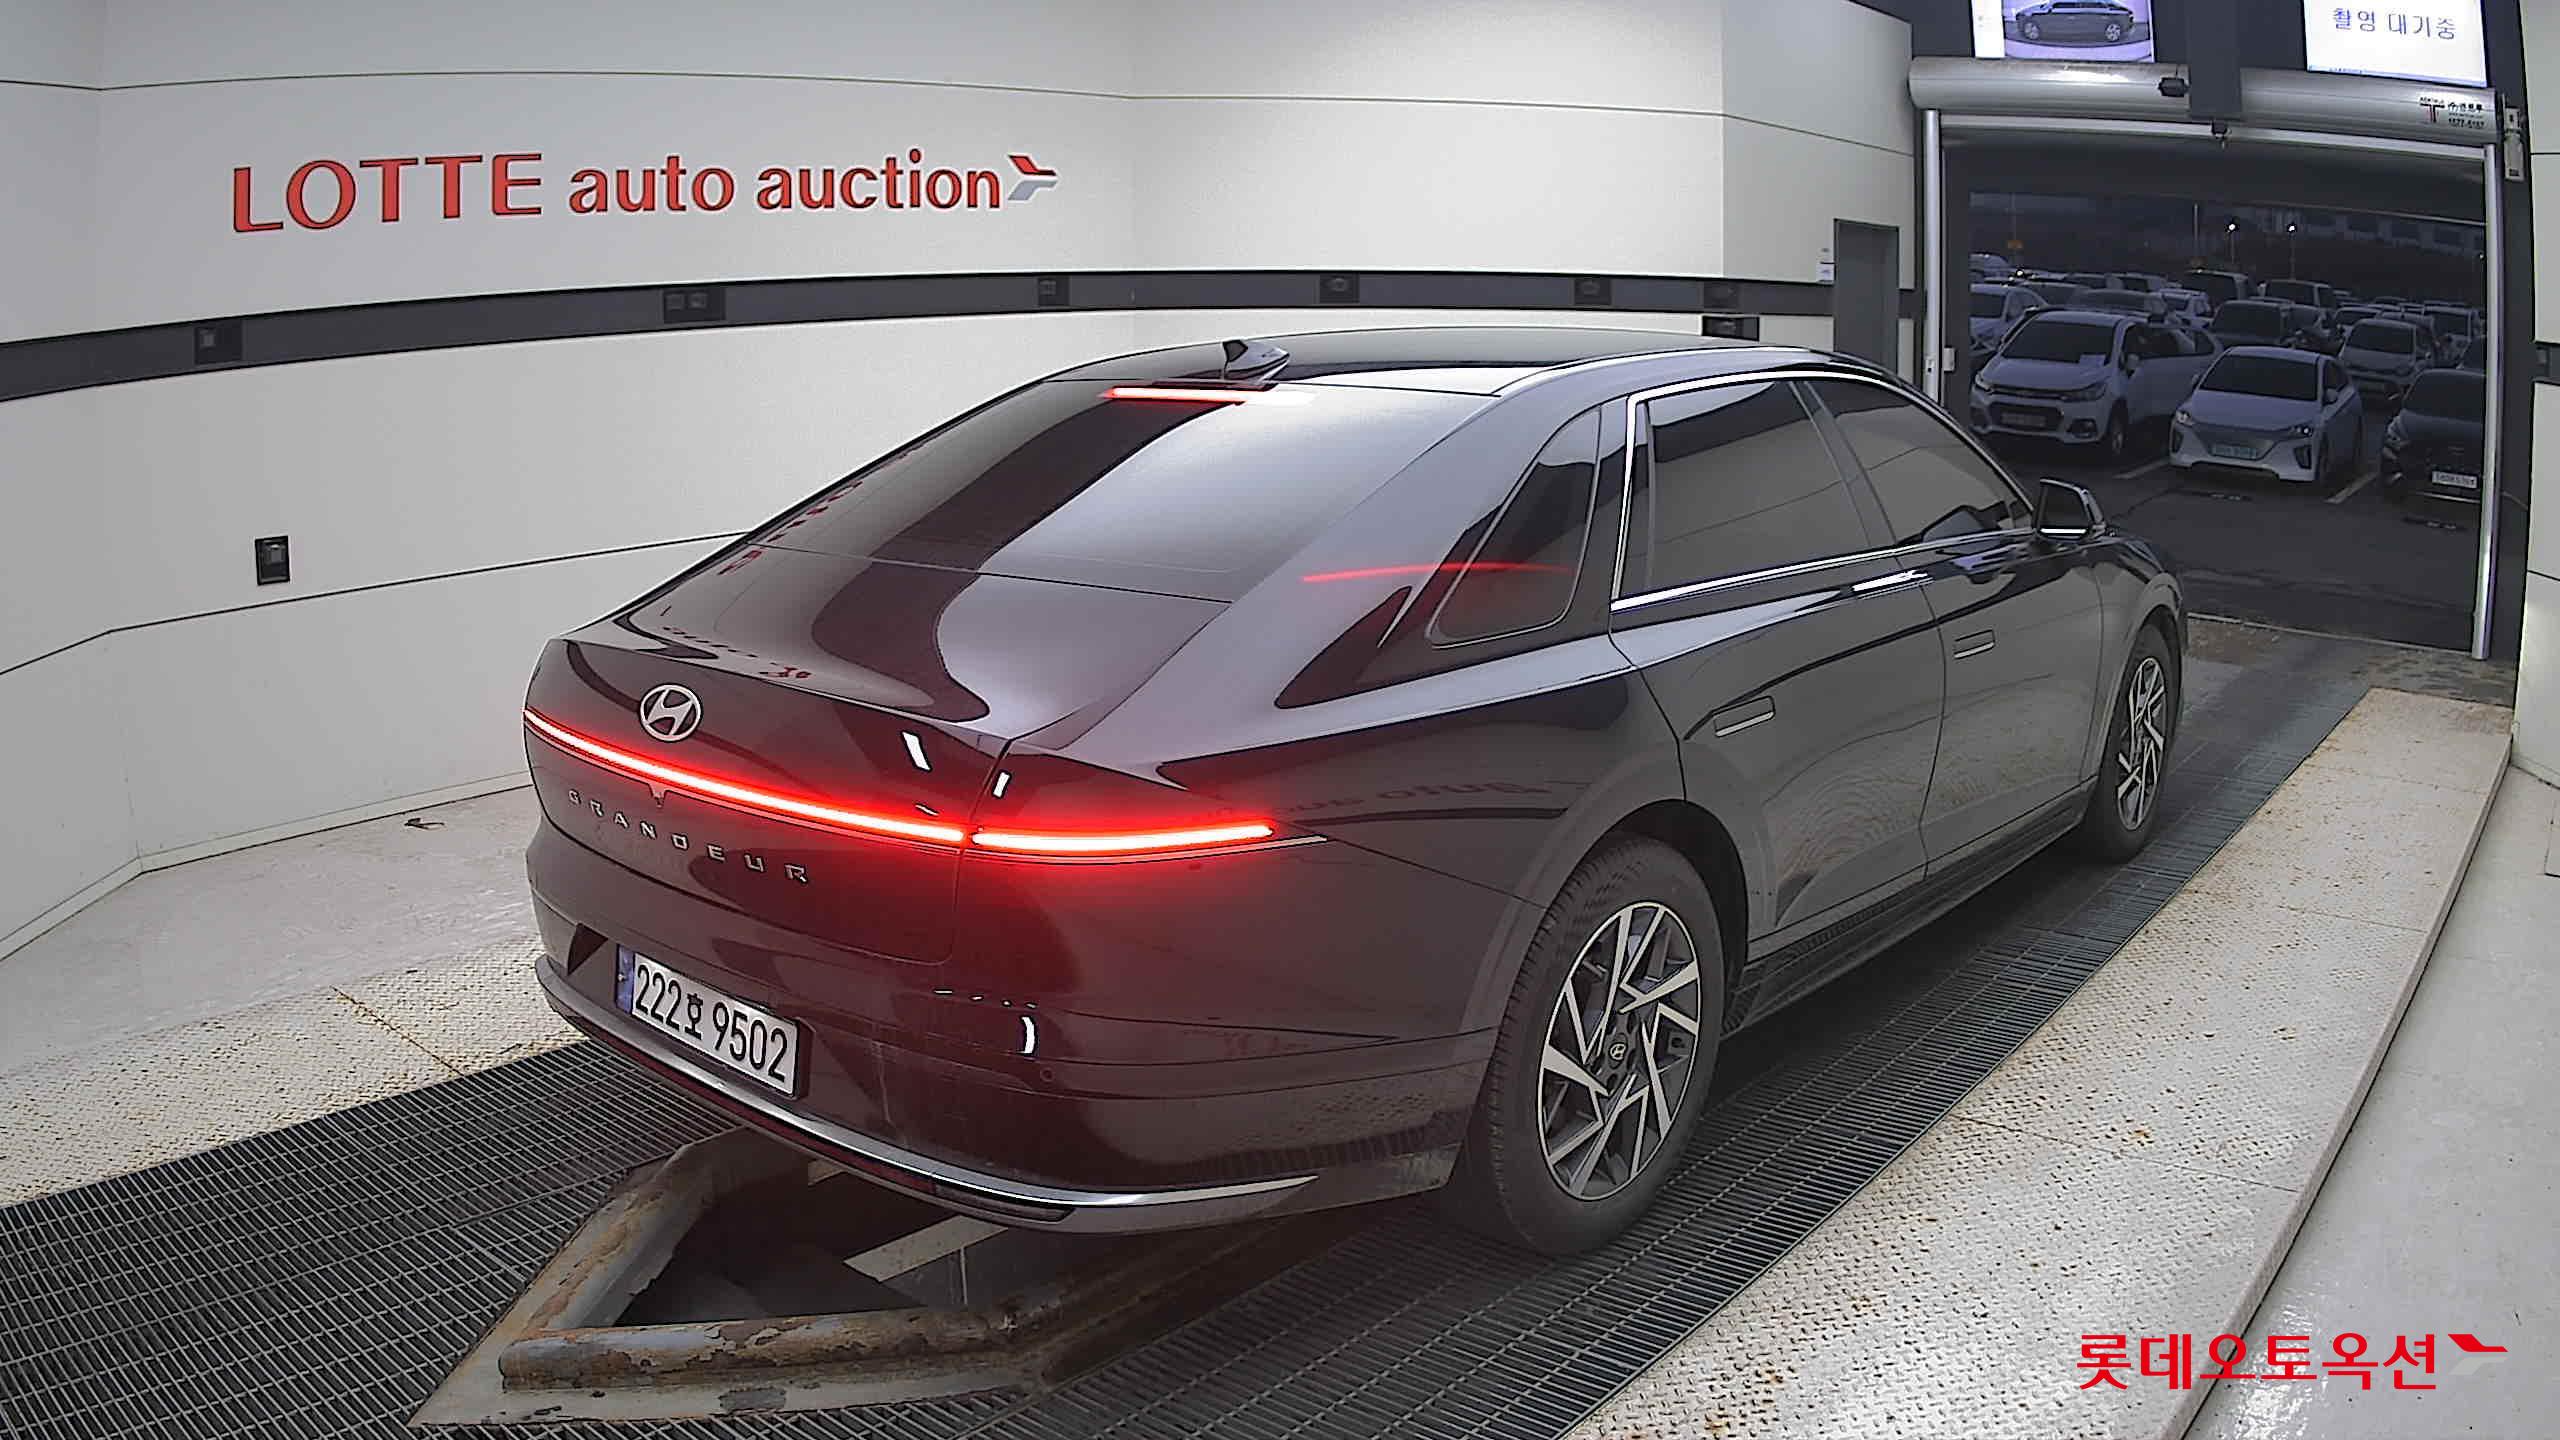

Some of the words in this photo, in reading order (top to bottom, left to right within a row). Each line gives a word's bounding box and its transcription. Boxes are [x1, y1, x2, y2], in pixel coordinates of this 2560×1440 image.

[2387, 13, 2456, 41] 대기중
[233, 152, 543, 232] LOTTE
[568, 155, 735, 214] auto
[757, 147, 1001, 210] auction
[568, 789, 809, 884] GRANDEUR
[635, 963, 704, 1041] 222호
[712, 1001, 789, 1084] 9502
